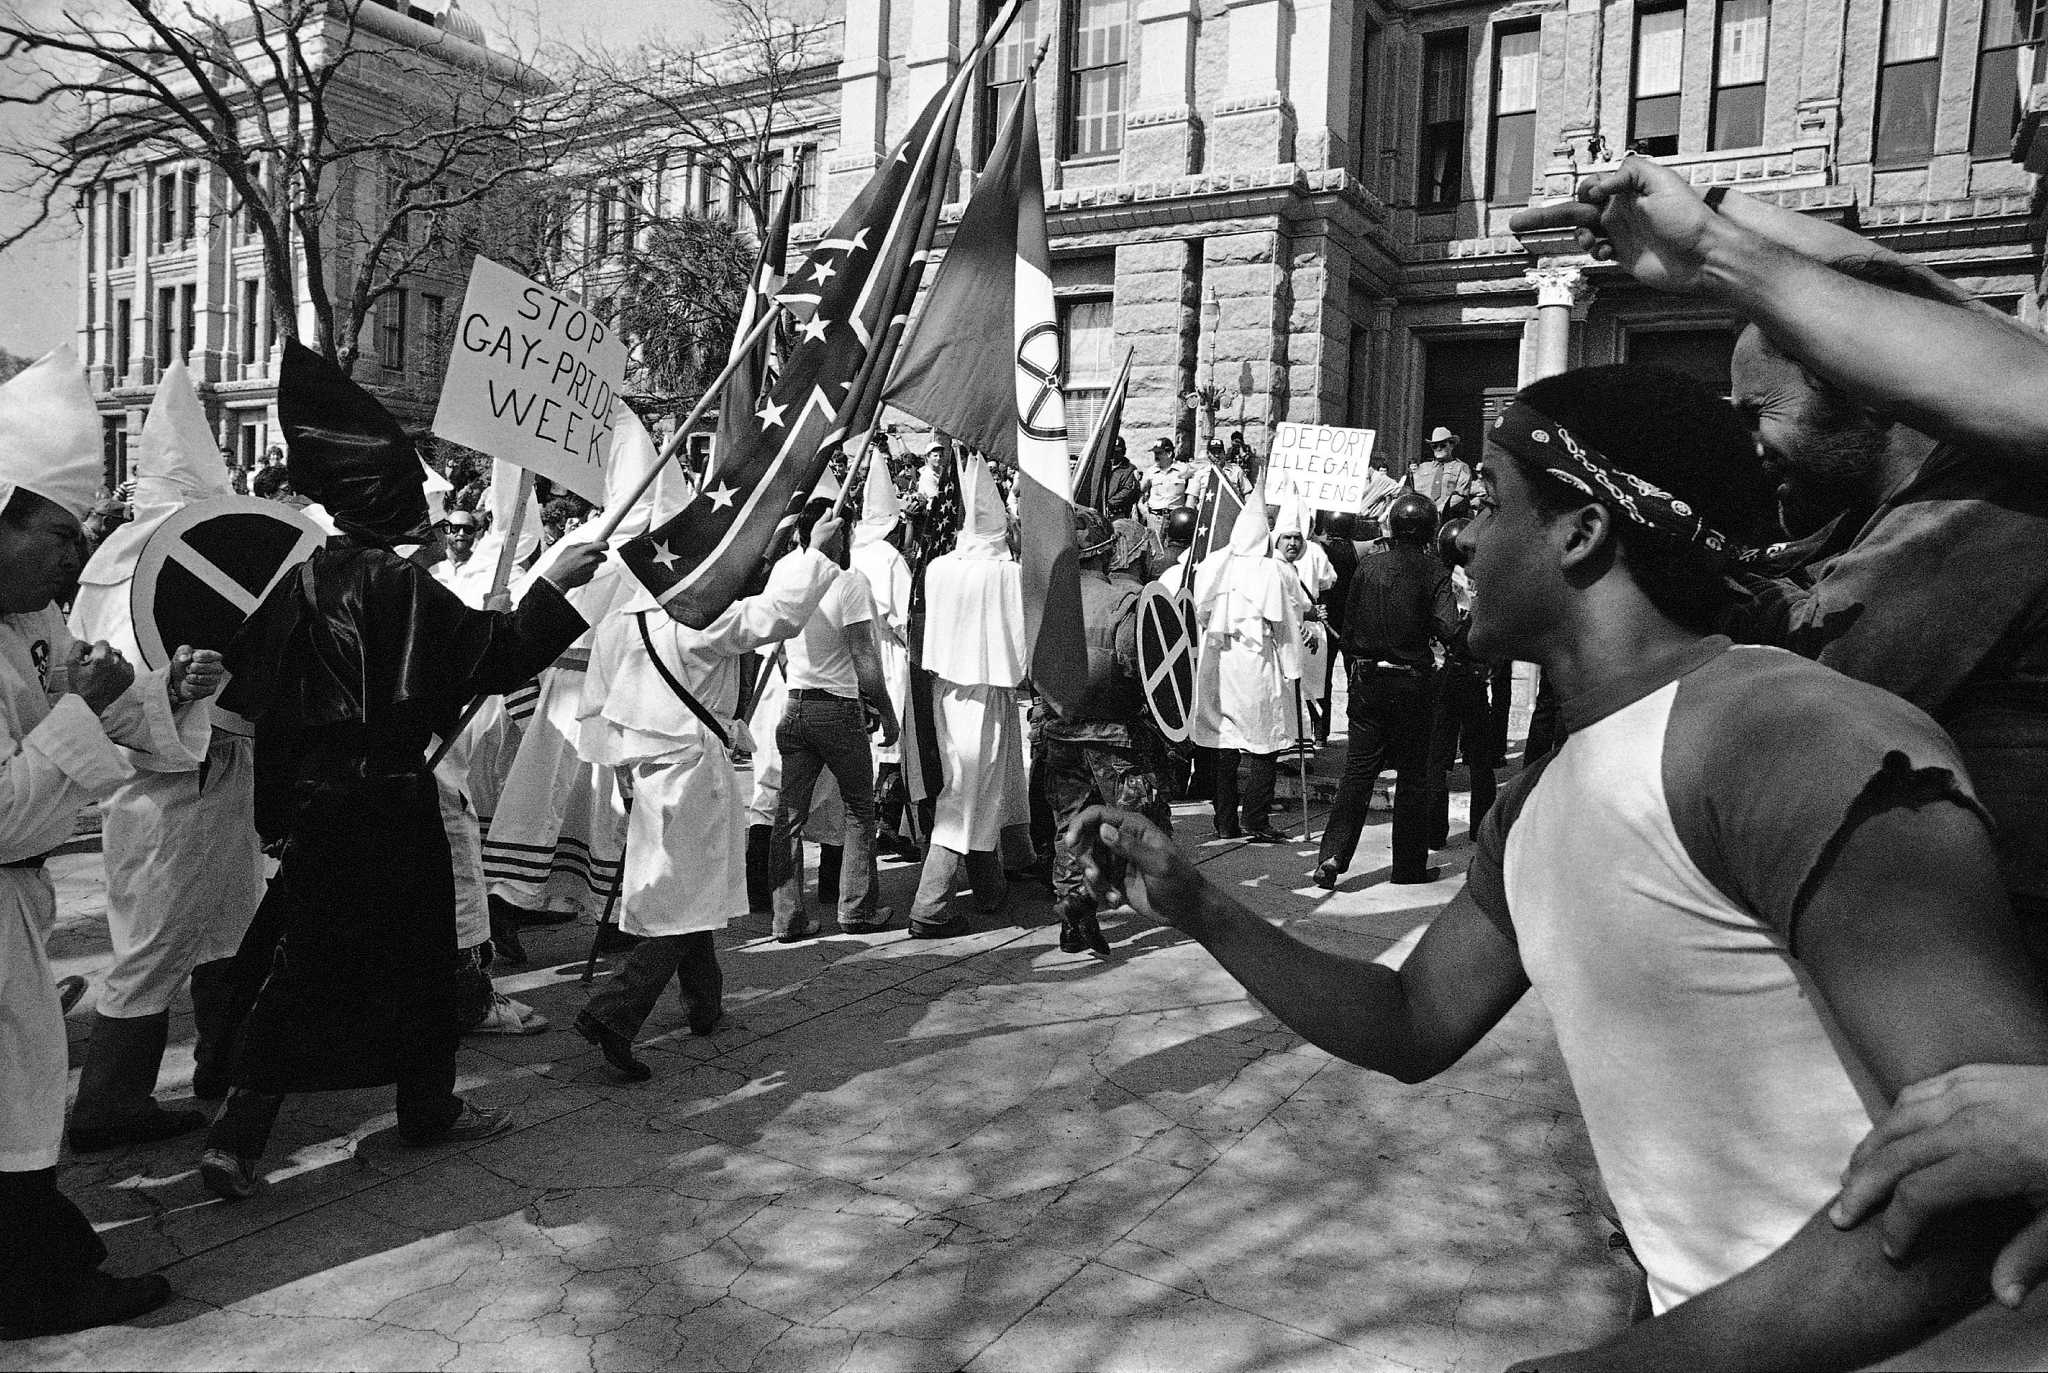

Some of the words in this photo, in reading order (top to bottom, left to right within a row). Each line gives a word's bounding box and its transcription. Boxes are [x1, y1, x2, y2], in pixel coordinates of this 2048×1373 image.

[518, 287, 604, 354] STOP
[463, 313, 619, 431] GAY-PRIDE
[489, 379, 604, 468] WEEK
[1282, 427, 1373, 459] DEPORT
[1270, 452, 1360, 477] ILLEGAL
[1275, 480, 1359, 503] AIENS
